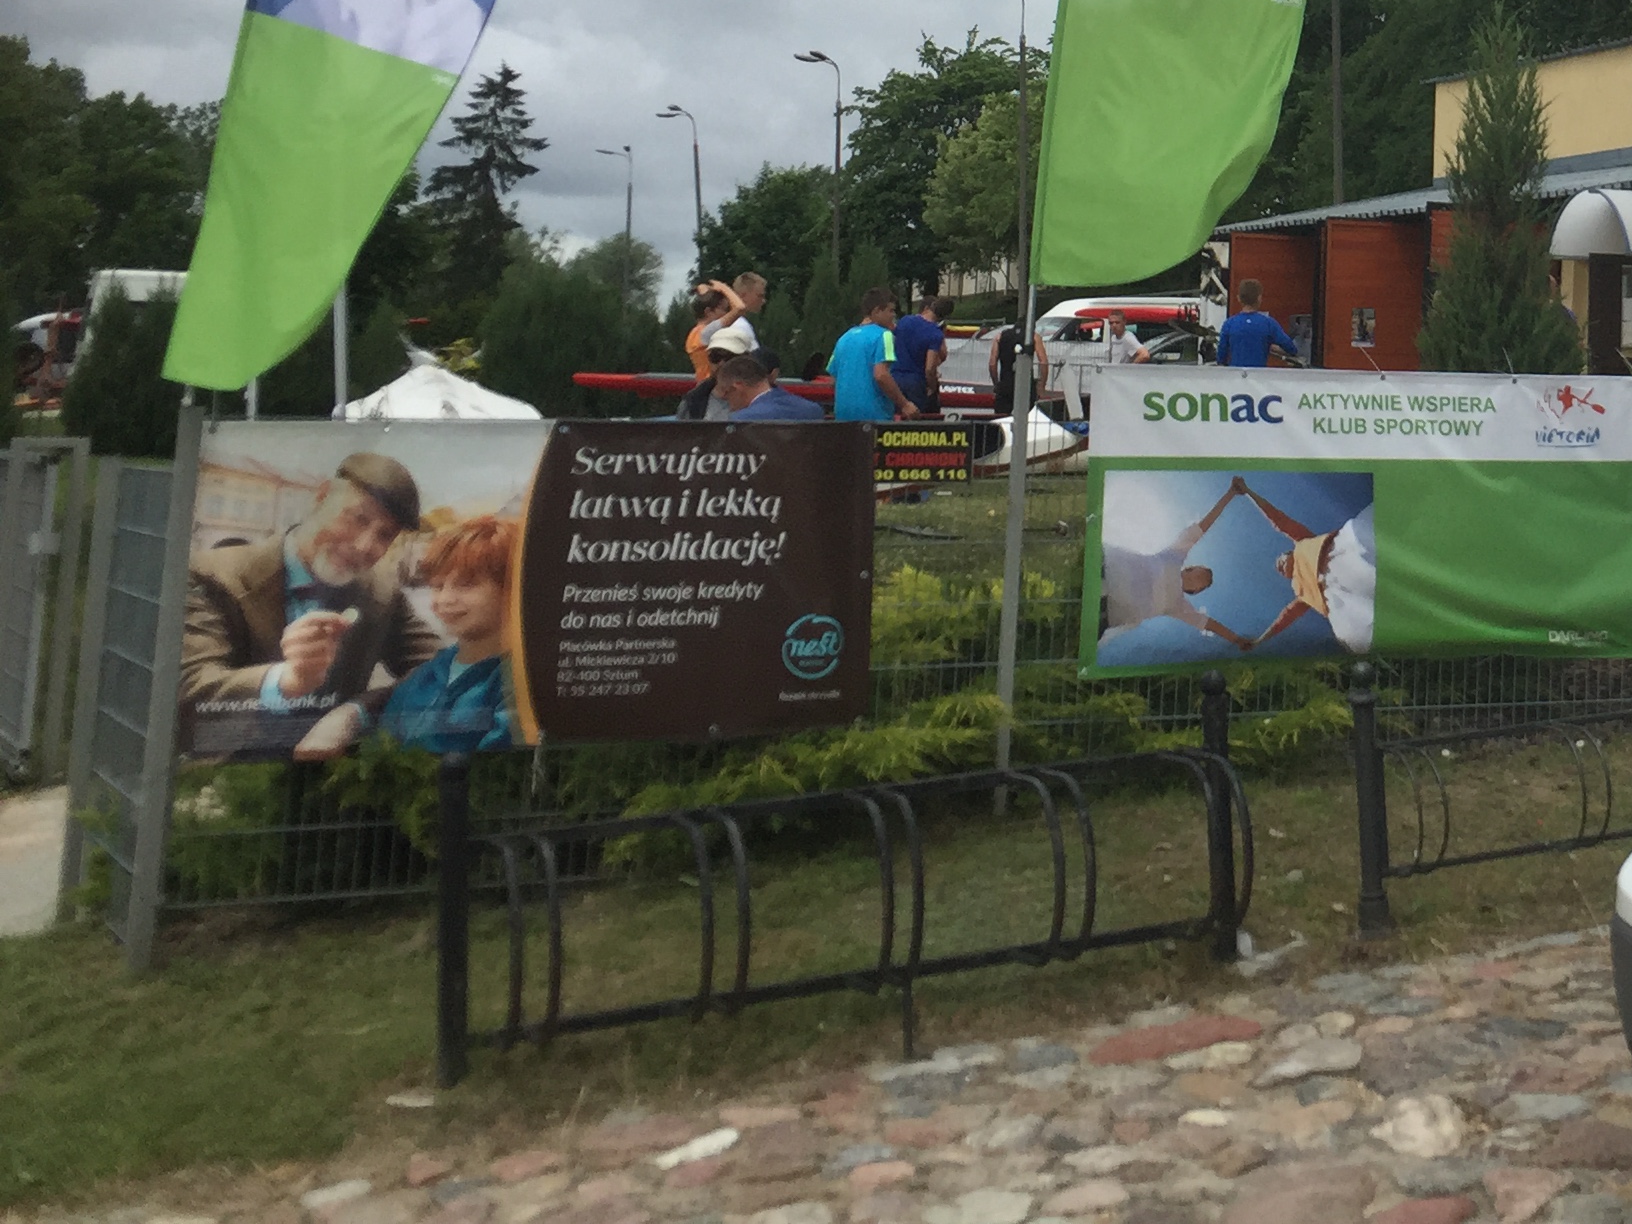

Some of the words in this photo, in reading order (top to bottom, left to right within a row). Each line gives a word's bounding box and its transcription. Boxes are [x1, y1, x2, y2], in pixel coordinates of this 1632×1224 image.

[1143, 391, 1284, 424] sonac
[1298, 393, 1403, 412] AKTYWNIE
[1407, 395, 1497, 413] WSPIERA
[874, 431, 969, 447] -OCHRONA.PL
[1313, 417, 1368, 434] KLUB
[1373, 418, 1484, 437] SPORTOWY
[570, 446, 767, 480] Serwujemy
[569, 489, 673, 525] łatwą
[677, 489, 692, 517] i
[695, 488, 782, 524] lekką
[566, 531, 787, 566] konsolidację!
[562, 581, 639, 603] Przenieś
[642, 581, 694, 604] swoje
[697, 579, 764, 602] kredyty
[560, 611, 584, 629] do
[589, 614, 622, 628] nas
[626, 608, 636, 627] i
[637, 606, 721, 628] odetchnij
[789, 631, 840, 657] nest
